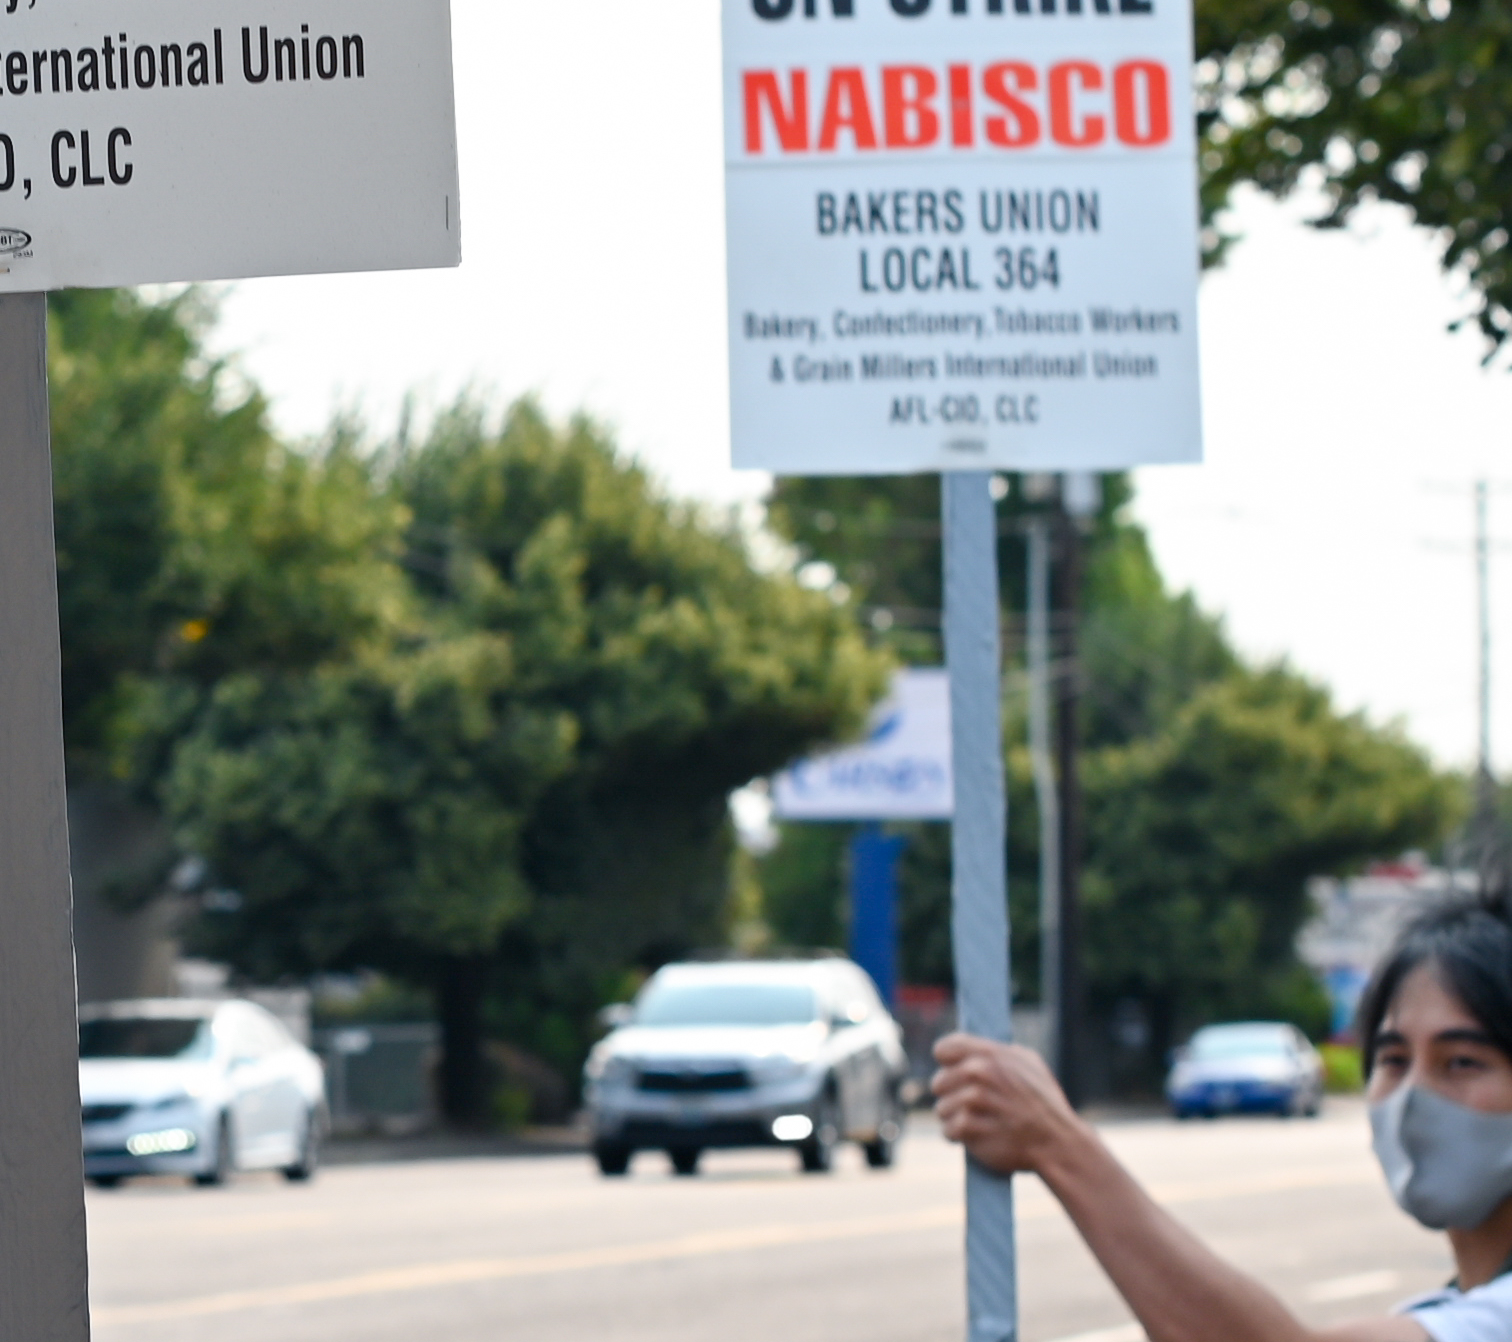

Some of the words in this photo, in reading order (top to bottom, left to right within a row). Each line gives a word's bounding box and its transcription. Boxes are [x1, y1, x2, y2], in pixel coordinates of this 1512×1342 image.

[241, 23, 365, 84] Union
[741, 59, 1171, 155] NABISCO
[50, 127, 134, 189] CLC
[816, 188, 965, 237] BAKERS
[979, 188, 1100, 235] UNION
[859, 246, 980, 294] LOCAL
[994, 246, 1061, 291] 364
[1089, 307, 1181, 335] Workers
[792, 354, 854, 383] Grain
[860, 351, 937, 380] Millers
[944, 349, 1086, 379] International
[1092, 349, 1159, 379] Union
[994, 393, 1040, 426] CLC
